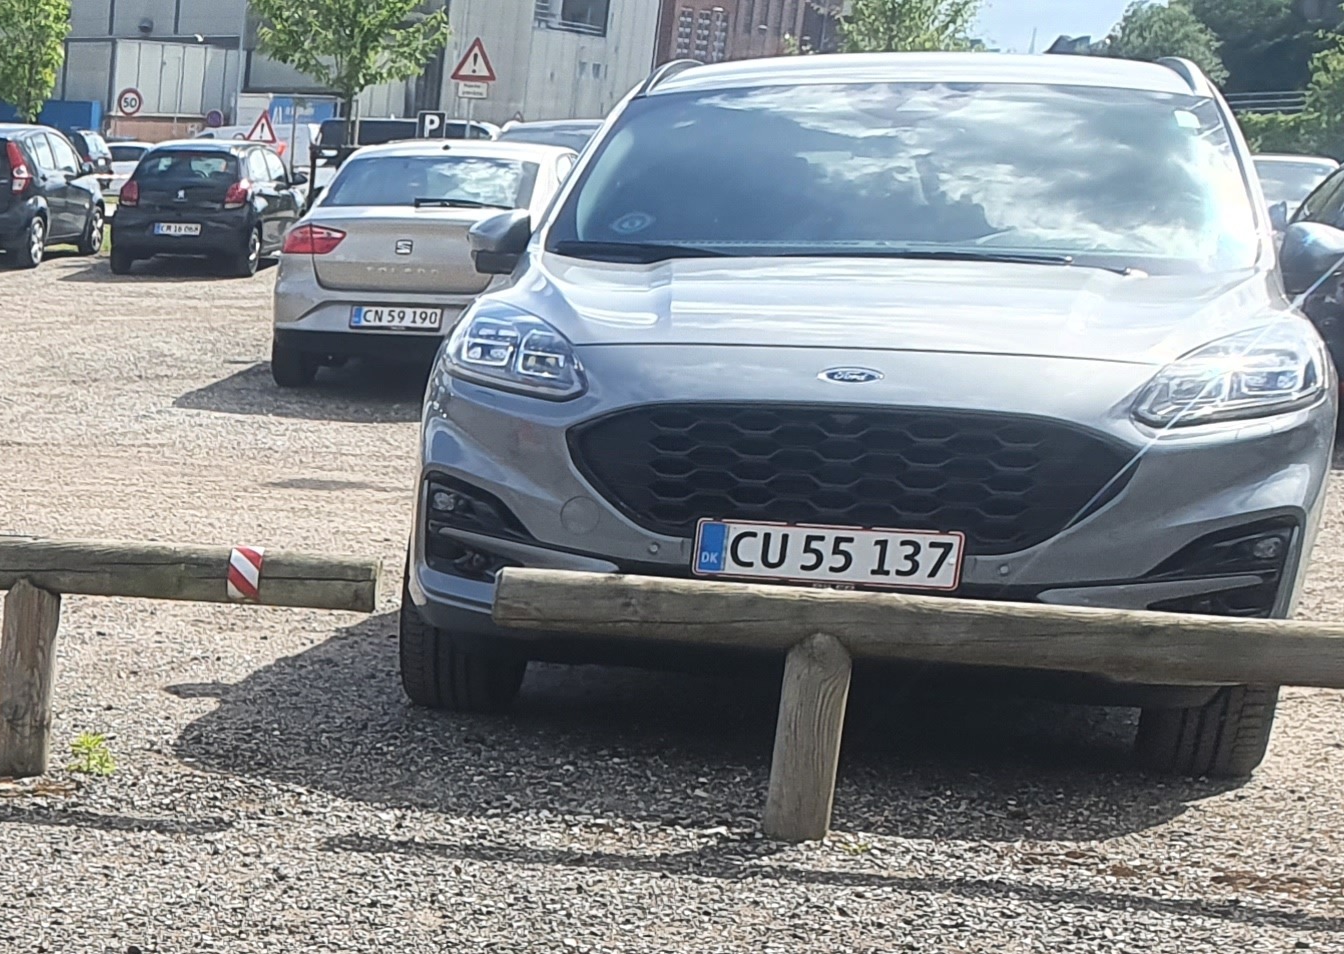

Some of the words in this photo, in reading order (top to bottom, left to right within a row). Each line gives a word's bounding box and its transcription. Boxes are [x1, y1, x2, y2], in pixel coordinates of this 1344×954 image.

[123, 97, 137, 109] 50
[424, 114, 441, 138] P
[363, 309, 384, 323] CN
[387, 309, 406, 324] 59
[410, 310, 438, 325] 190
[701, 551, 718, 564] DK
[730, 531, 790, 569] CU
[799, 534, 855, 573] 55
[870, 539, 954, 579] 137
